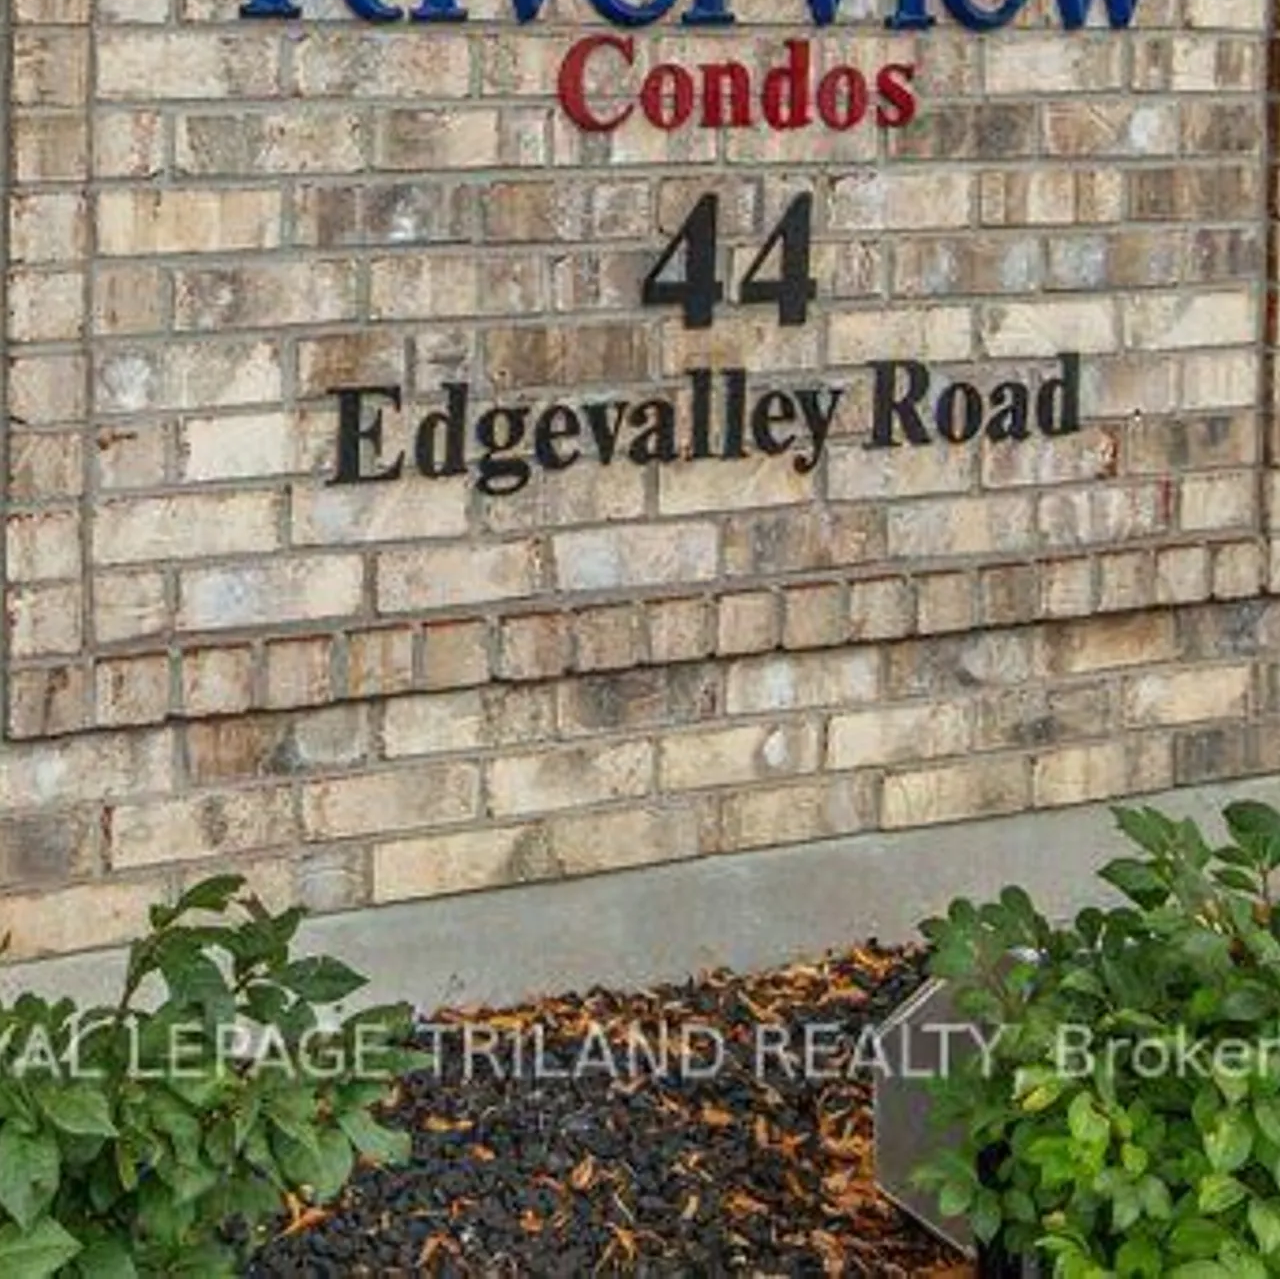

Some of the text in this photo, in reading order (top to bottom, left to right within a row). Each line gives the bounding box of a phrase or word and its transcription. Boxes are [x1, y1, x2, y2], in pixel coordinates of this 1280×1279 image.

[558, 35, 920, 132] Condos
[641, 192, 818, 329] 44
[324, 352, 1082, 495] Edgevalley Road
